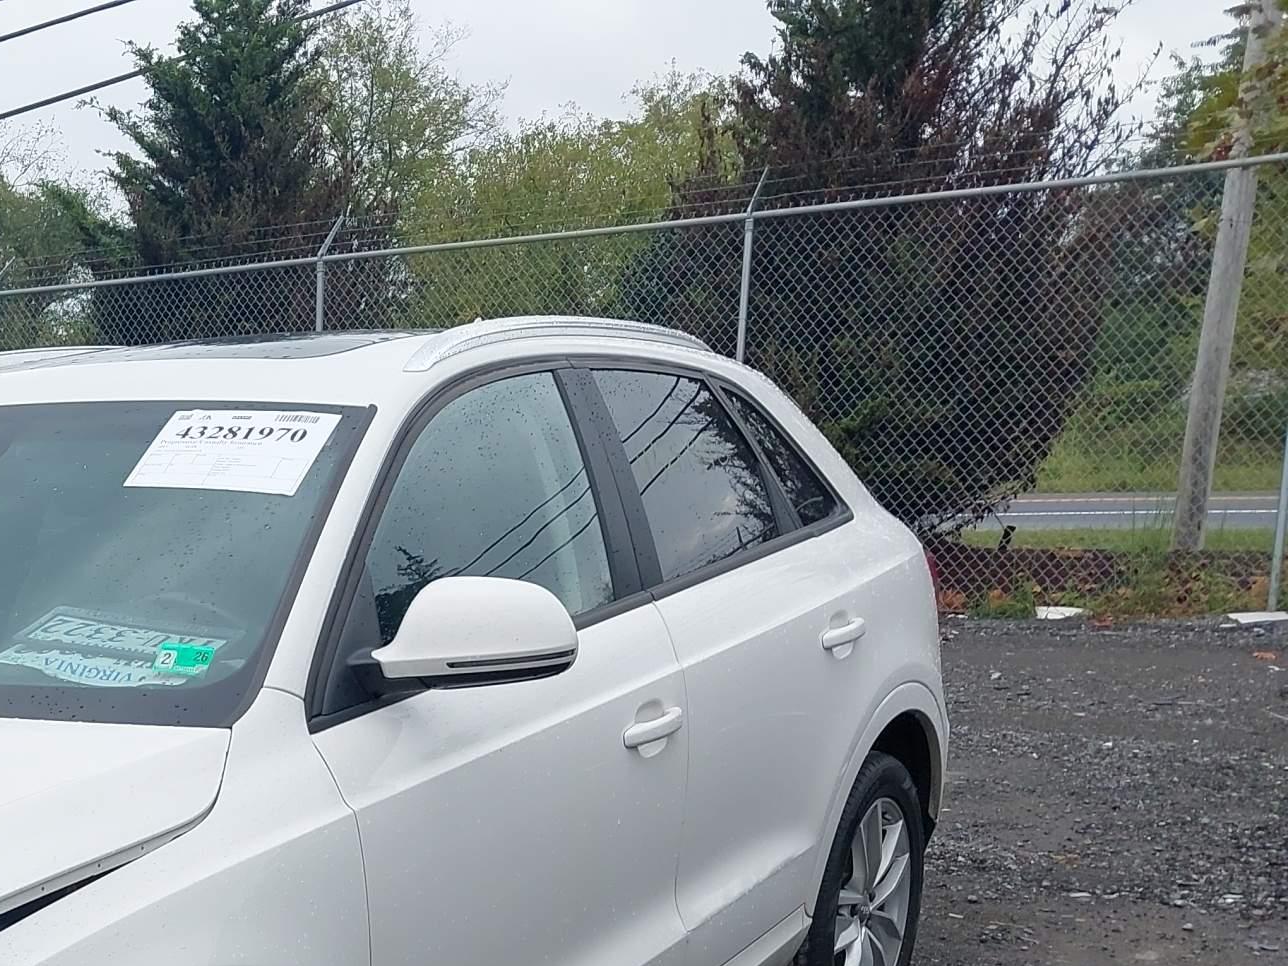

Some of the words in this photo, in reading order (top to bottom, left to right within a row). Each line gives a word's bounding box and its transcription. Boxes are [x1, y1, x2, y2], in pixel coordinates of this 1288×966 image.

[175, 425, 308, 443] 43281970
[160, 652, 172, 665] 2
[193, 651, 209, 663] 26
[43, 655, 133, 683] VIRGINIA
